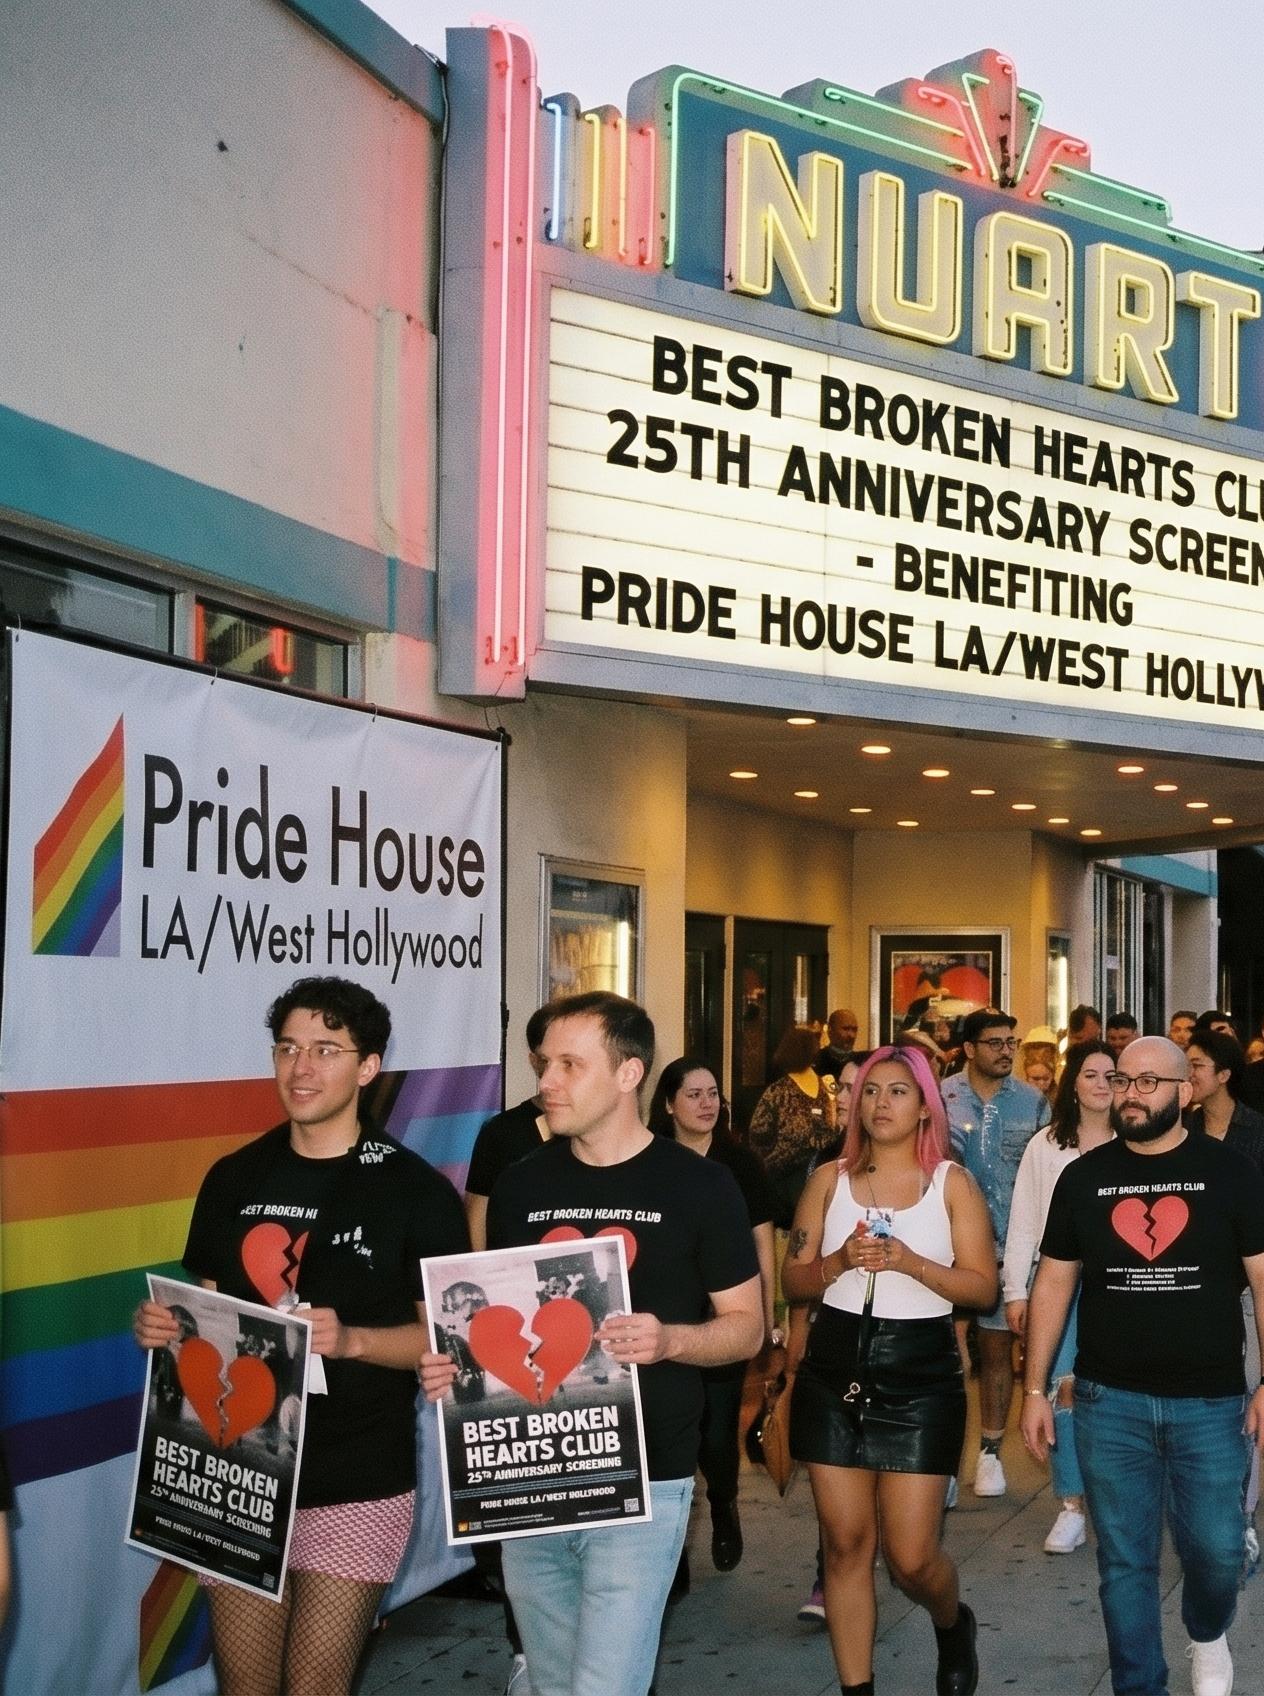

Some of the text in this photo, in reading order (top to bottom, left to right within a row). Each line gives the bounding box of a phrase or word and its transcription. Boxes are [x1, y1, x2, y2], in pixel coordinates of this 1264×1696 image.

[725, 128, 1262, 422] NUART
[651, 335, 793, 418] BEST
[819, 373, 1012, 470] BROKEN
[1034, 424, 1197, 508] HEARTS
[606, 409, 751, 490] 25TH
[777, 445, 1111, 559] ANNIVERSARY
[894, 542, 1134, 629] BENEFITING
[580, 565, 738, 641] PRIDE
[760, 593, 914, 665] HOUSE
[934, 619, 1129, 693] LA/WEST
[143, 753, 485, 898] Pride House
[140, 894, 484, 985] LA/West Hollywood
[528, 1208, 662, 1223] BEST BROKEN HEARTS CLUB
[1119, 1185, 1149, 1195] BROKEN
[1151, 1183, 1182, 1193] HEARTS
[1184, 1182, 1205, 1191] CLUB
[463, 1405, 618, 1443] BEST BROKEN
[466, 1431, 620, 1468] HEARTS CLUB
[153, 1460, 274, 1523] HEARTS CLUB
[155, 1436, 279, 1500] BEST BROKEN
[566, 1456, 621, 1472] SCREENING
